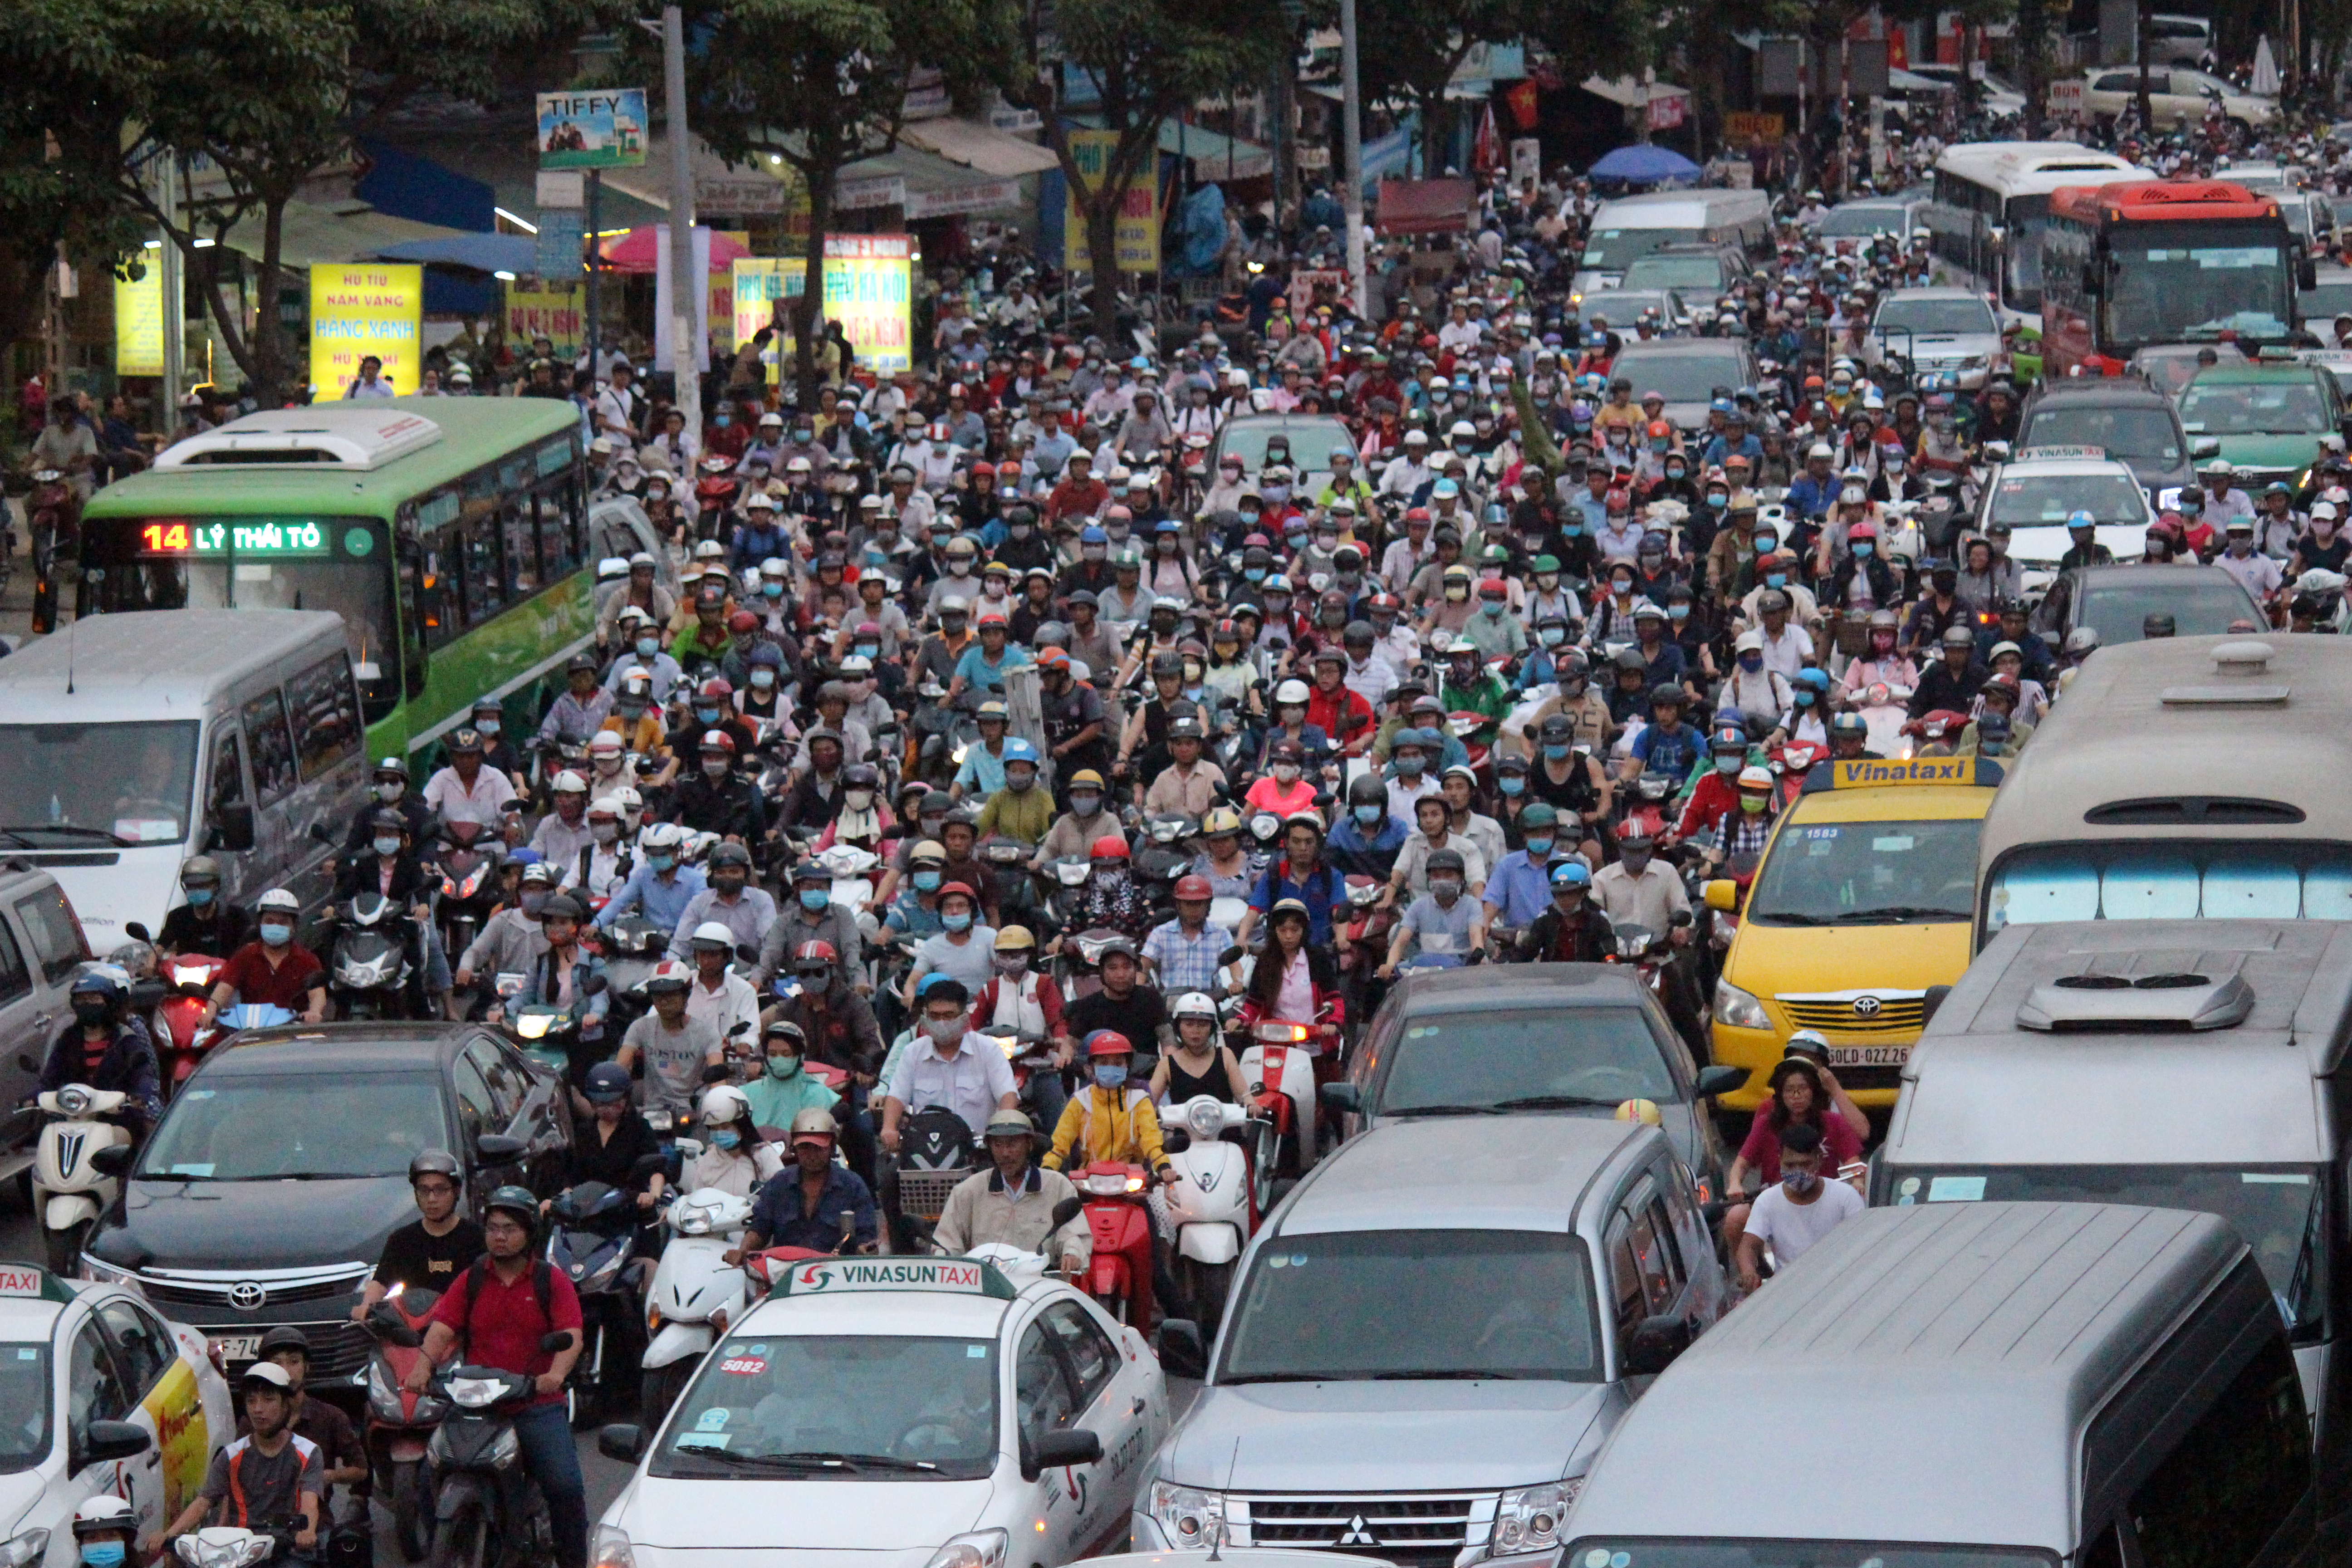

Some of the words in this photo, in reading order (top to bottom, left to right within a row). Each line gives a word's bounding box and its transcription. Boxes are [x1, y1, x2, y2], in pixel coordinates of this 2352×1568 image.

[547, 97, 620, 116] TIFFY
[327, 295, 359, 306] NAM
[364, 295, 404, 307] VANG
[315, 314, 363, 338] HÀNG
[368, 318, 414, 338] XANH
[144, 524, 188, 550] 14
[233, 522, 282, 549] THÁI
[1845, 760, 1966, 782] Vinataxi
[1807, 828, 1838, 839] 1583
[0, 1273, 37, 1290] TAXI
[720, 1359, 765, 1373] 5082
